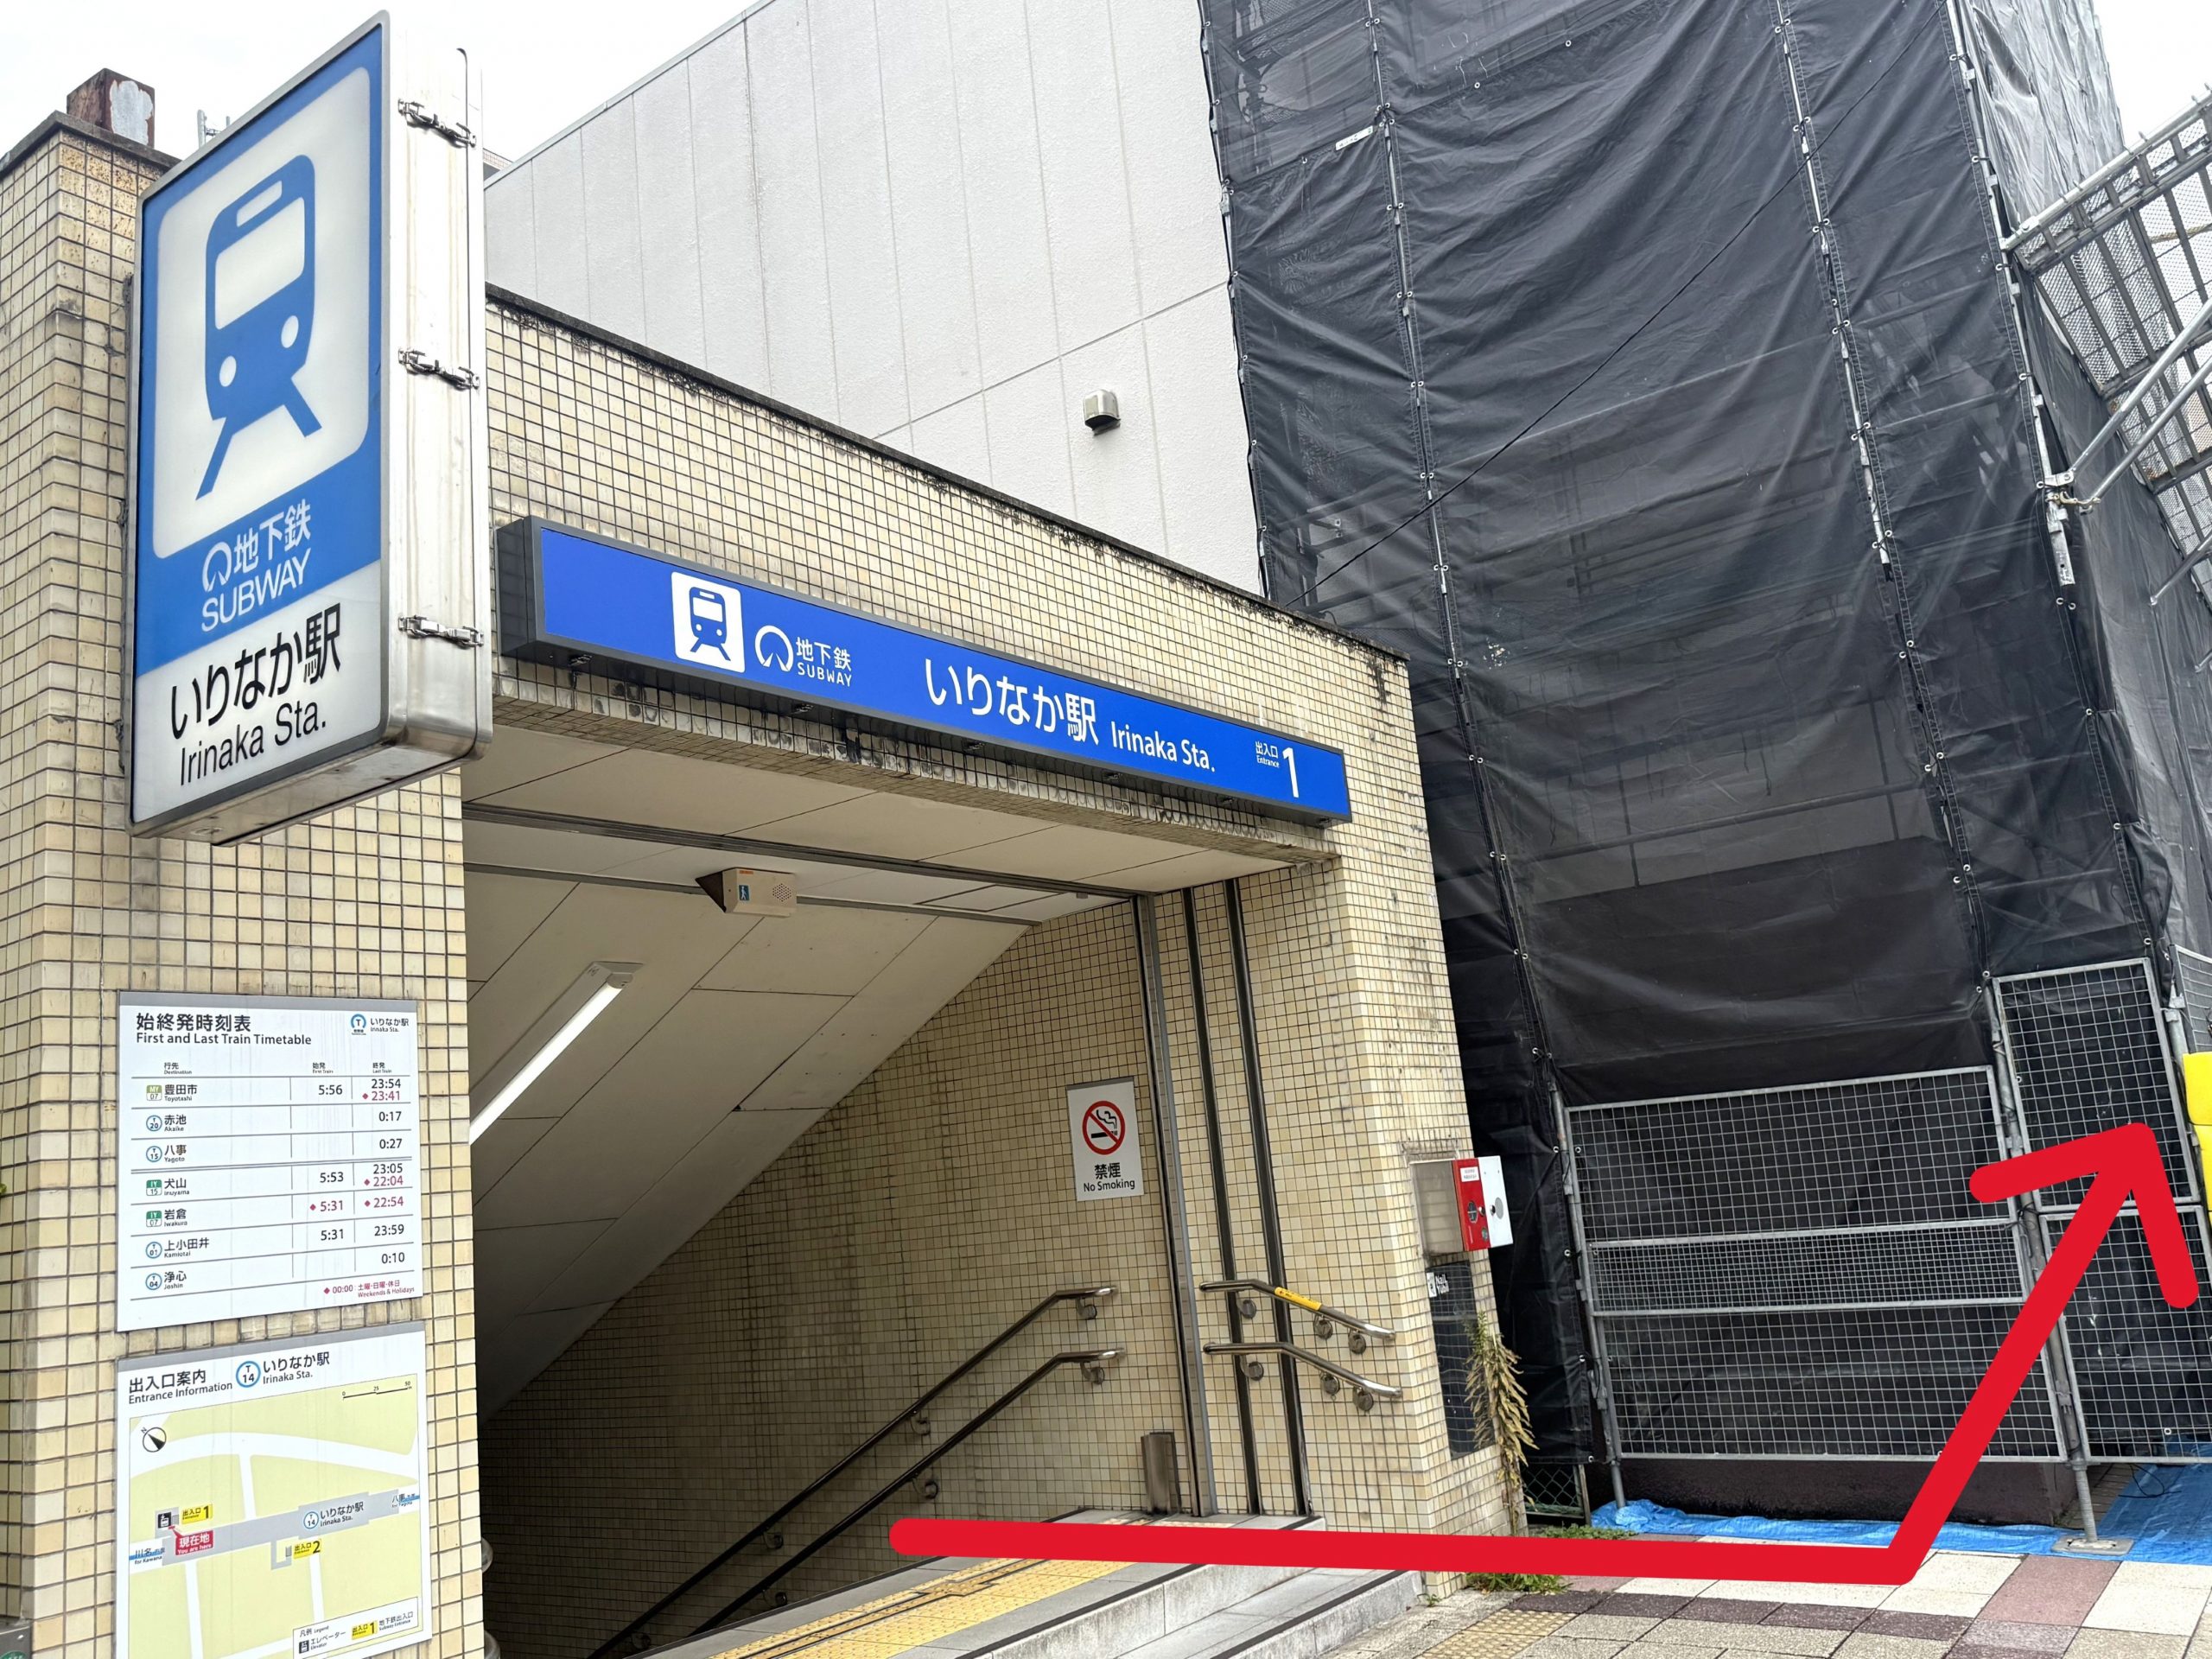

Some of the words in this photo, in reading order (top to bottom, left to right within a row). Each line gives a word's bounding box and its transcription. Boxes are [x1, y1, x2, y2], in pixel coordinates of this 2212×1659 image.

[233, 499, 311, 572] 地下鉄
[201, 548, 311, 632] SUBWAY
[796, 636, 852, 672] 地下鉄
[172, 602, 341, 740] いりなか駅
[798, 663, 852, 688] SUBWAY
[925, 658, 1099, 745] いりなか駅
[1111, 721, 1177, 762] Irinaka
[1181, 739, 1216, 772] Sta.
[181, 724, 264, 785] Irinaka
[275, 701, 326, 746] Sta.
[1255, 741, 1278, 759] 出入口
[1256, 754, 1280, 768] Entrance
[1282, 747, 1299, 798] 1
[137, 1013, 251, 1032] 始終発時刻表
[371, 1018, 409, 1027] いりなか駅
[137, 1033, 164, 1044] First
[168, 1033, 190, 1044] and
[194, 1033, 219, 1044] Last
[221, 1033, 251, 1044] Train
[253, 1033, 312, 1045] Timetable
[164, 1084, 197, 1095] 豊田市
[318, 1084, 342, 1095] 5:56
[372, 1078, 401, 1089] 23:54
[372, 1090, 400, 1101] 23:41
[164, 1115, 187, 1125] 赤池
[378, 1111, 402, 1122] 0:17
[379, 1139, 402, 1148] 0:27
[164, 1145, 187, 1155] 八事
[373, 1163, 403, 1174] 23:05
[1095, 1162, 1121, 1179] 禁煙
[164, 1178, 187, 1189] 犬山
[320, 1172, 344, 1183] 5:53
[373, 1175, 404, 1187] 22:04
[1084, 1183, 1096, 1192] No
[1097, 1179, 1135, 1192] Smoking
[320, 1200, 343, 1211] 5:31
[373, 1196, 404, 1208] 22:54
[164, 1208, 187, 1220] 岩倉
[321, 1229, 344, 1241] 5:31
[374, 1224, 404, 1236] 23:59
[164, 1237, 209, 1251] 上小田井
[381, 1252, 405, 1264] 0:10
[164, 1270, 187, 1283] 浄心
[358, 1289, 386, 1298] Weekends
[263, 1351, 330, 1373] いりなか駅
[130, 1369, 206, 1394] 出入口案内
[243, 1374, 254, 1382] 14
[263, 1373, 294, 1384] Irinaka
[296, 1370, 313, 1379] Sta.
[129, 1391, 173, 1404] Entrance
[175, 1382, 232, 1397] Information
[182, 1508, 201, 1516] 出入口
[204, 1505, 209, 1519] 1
[321, 1502, 364, 1519] いりなか駅
[321, 1518, 341, 1527] Irinaka
[179, 1533, 209, 1548] 現在地
[313, 1541, 321, 1554] 2
[370, 1622, 375, 1634] 1
